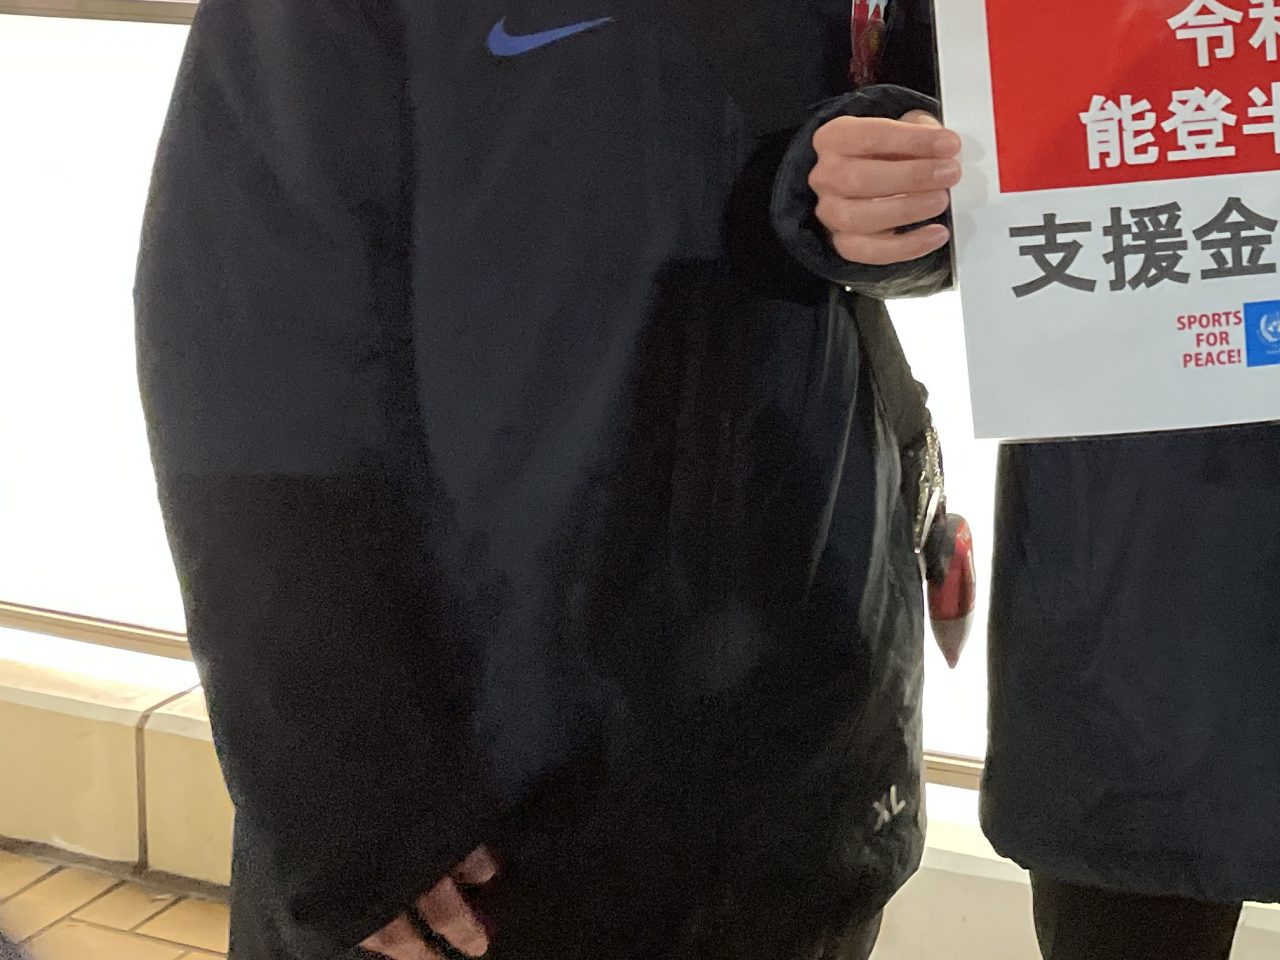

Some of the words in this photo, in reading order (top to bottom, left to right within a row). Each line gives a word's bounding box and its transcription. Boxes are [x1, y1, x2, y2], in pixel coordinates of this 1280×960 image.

[1176, 310, 1243, 331] SPORTS
[1195, 330, 1230, 348] FOR
[1182, 348, 1242, 368] PEACE!
[872, 783, 907, 832] XL
